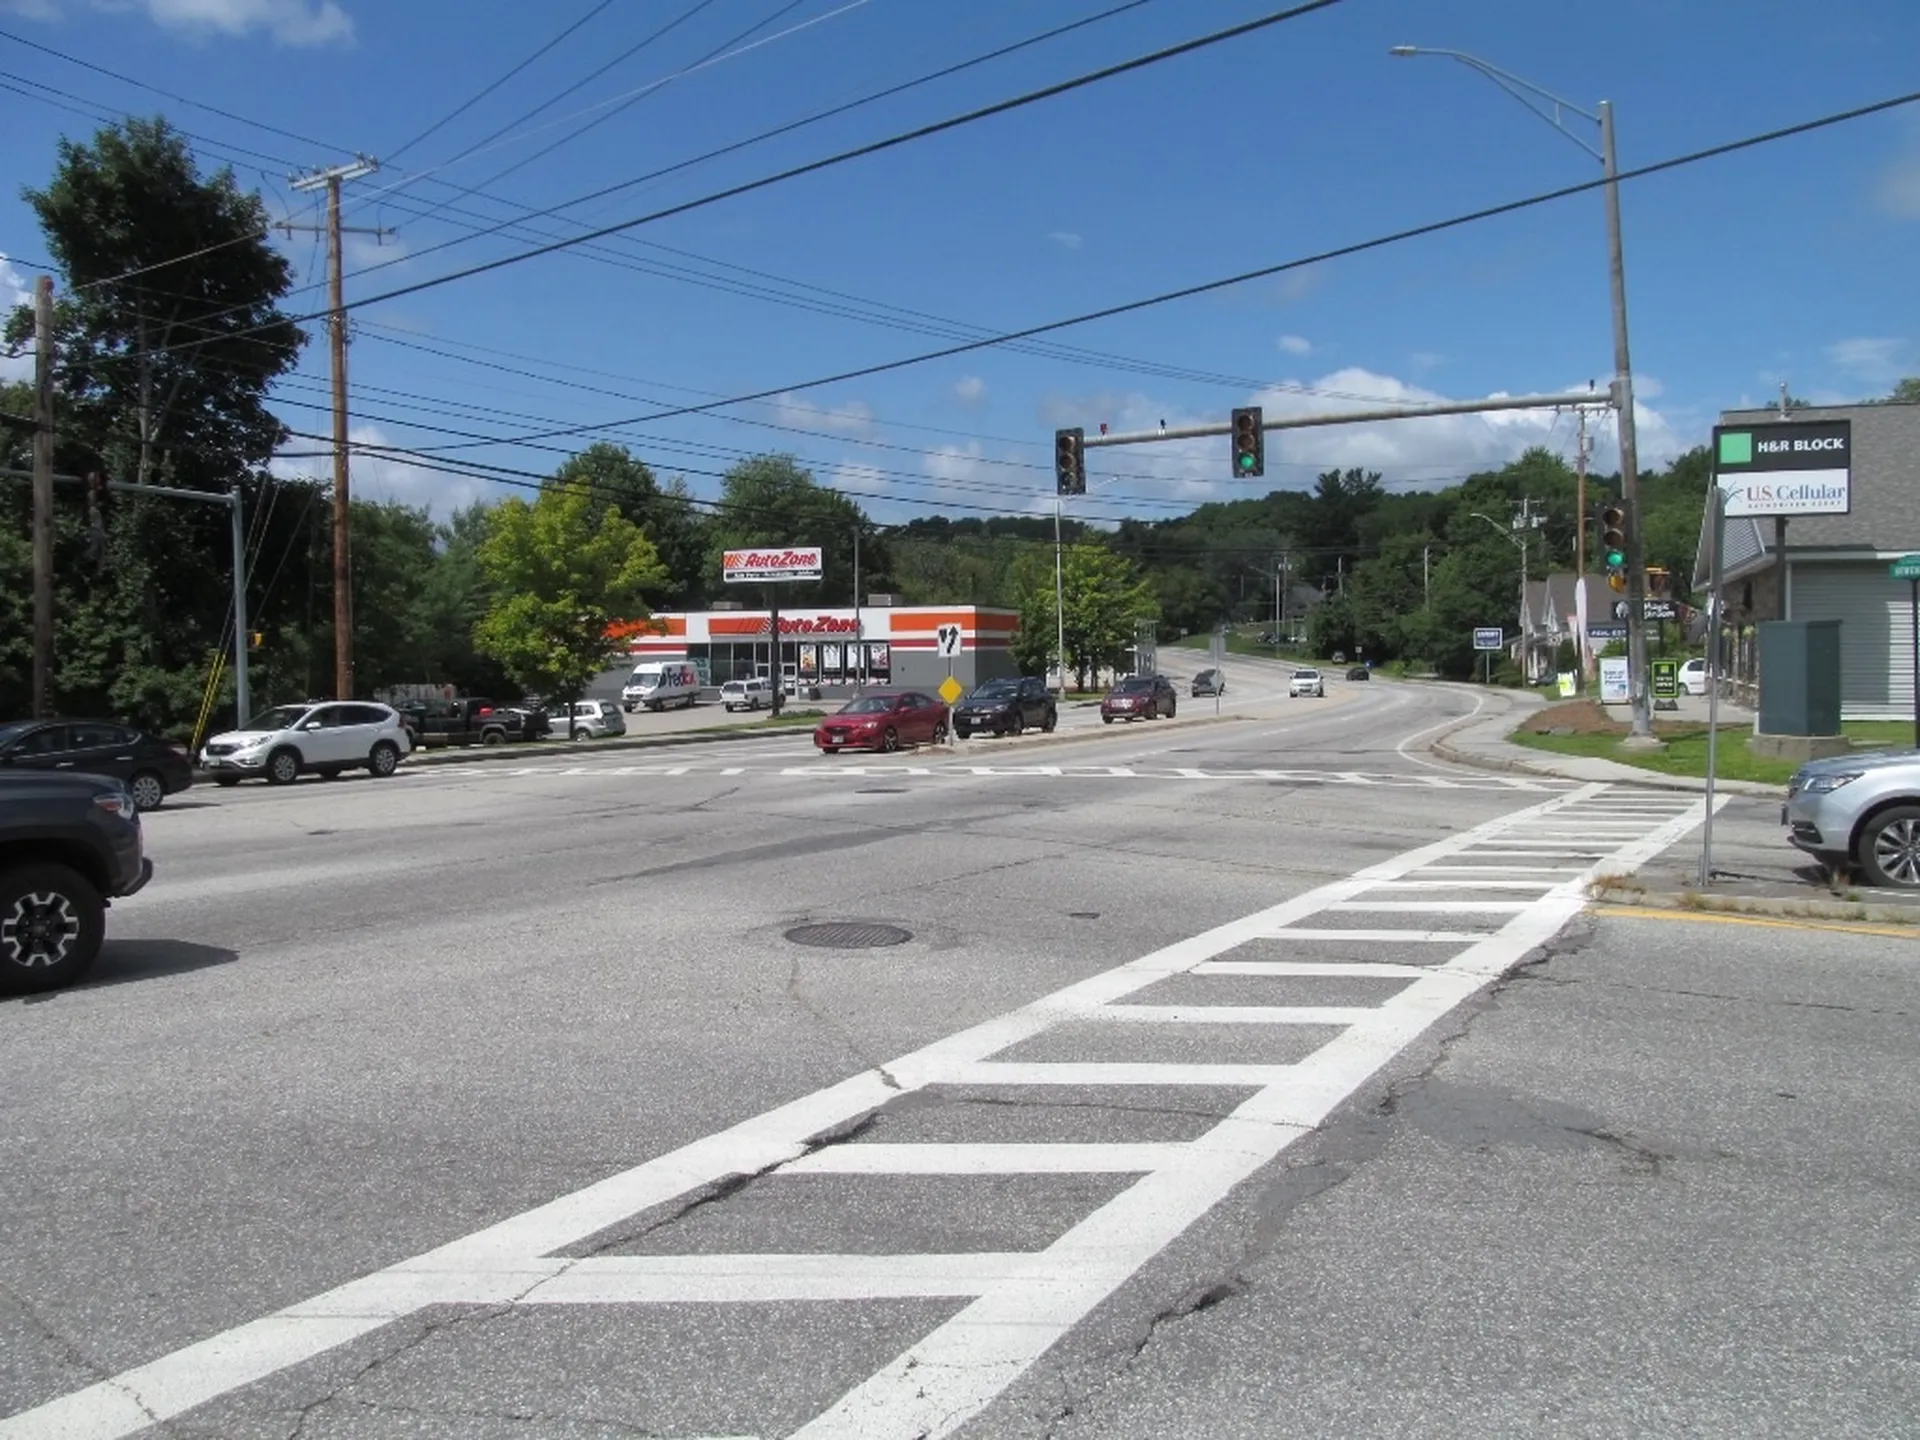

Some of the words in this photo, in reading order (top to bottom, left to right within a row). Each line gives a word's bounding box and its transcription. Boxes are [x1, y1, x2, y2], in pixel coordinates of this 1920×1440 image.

[1758, 440, 1789, 453] H&R
[1794, 438, 1844, 451] BLOCK
[1777, 483, 1846, 501] Cellular
[745, 551, 817, 568] AutoZone
[665, 664, 696, 687] FedEx
